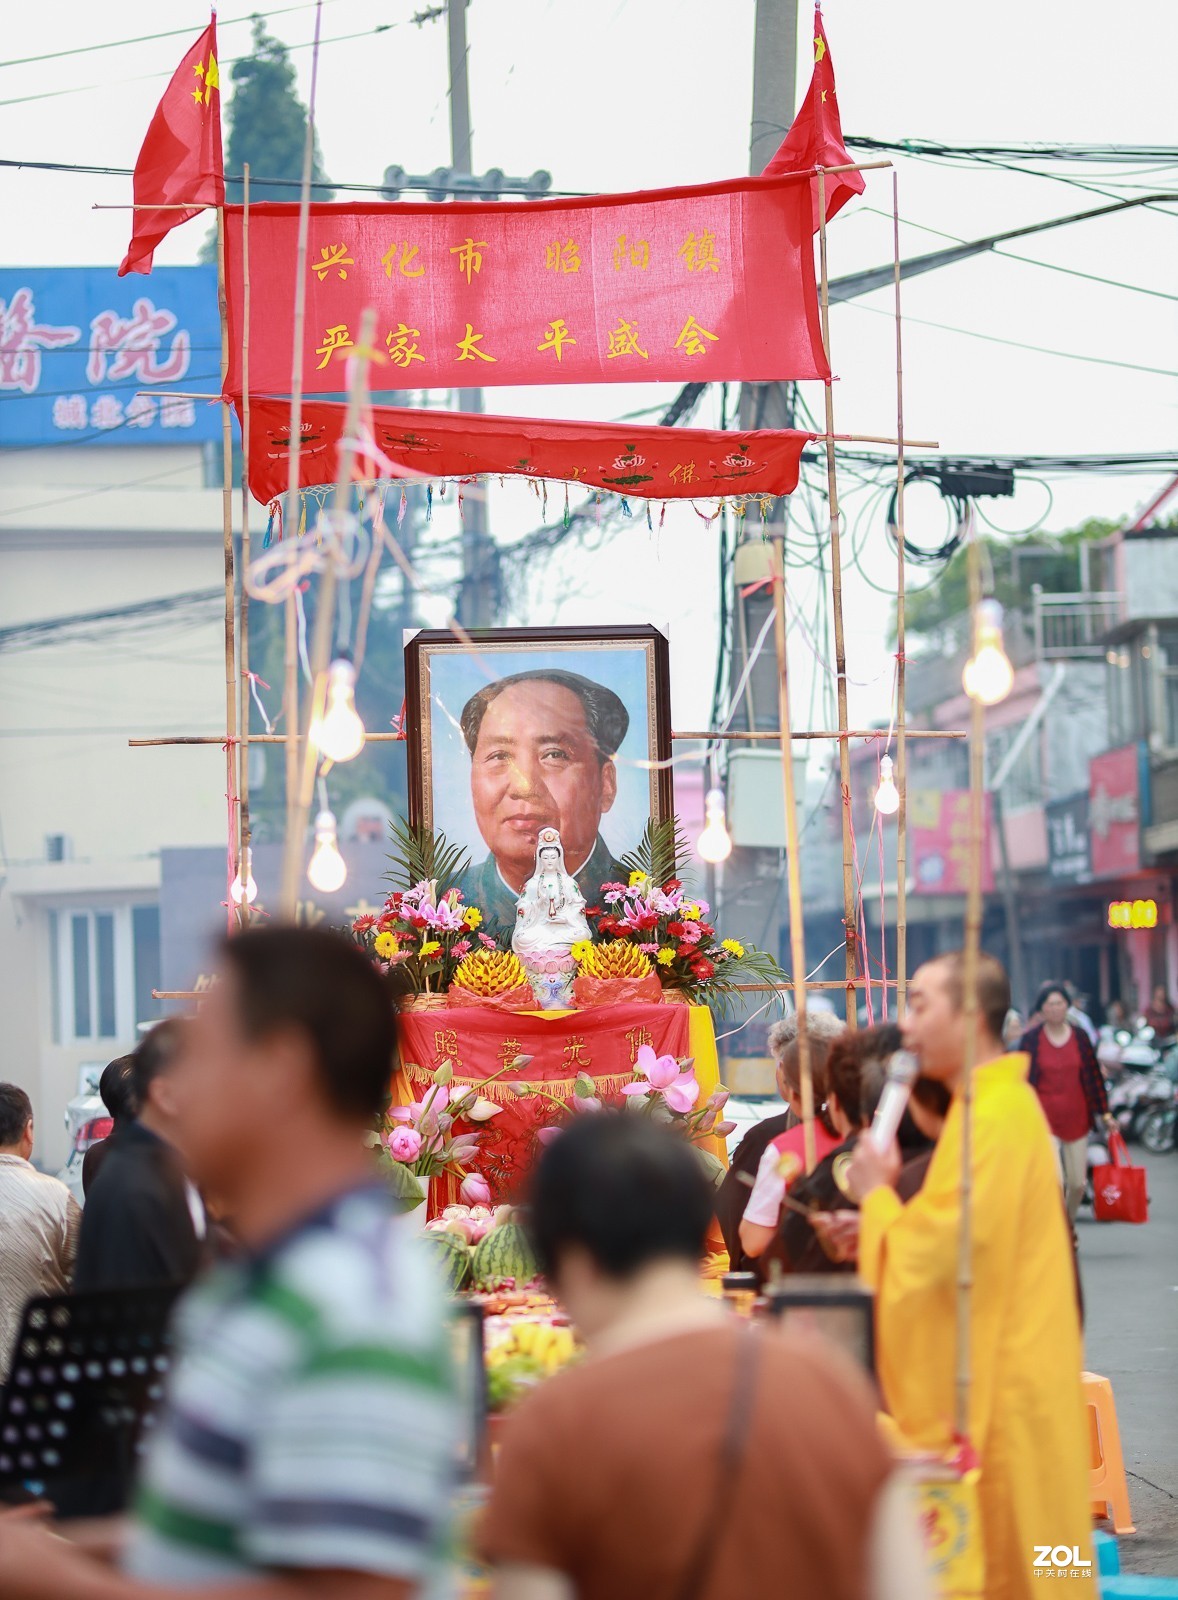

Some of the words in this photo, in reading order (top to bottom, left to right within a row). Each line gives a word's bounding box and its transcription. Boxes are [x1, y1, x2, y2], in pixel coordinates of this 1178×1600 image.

[311, 228, 720, 286] 兴化市昭阳镇
[315, 315, 720, 371] 严家太平盛会
